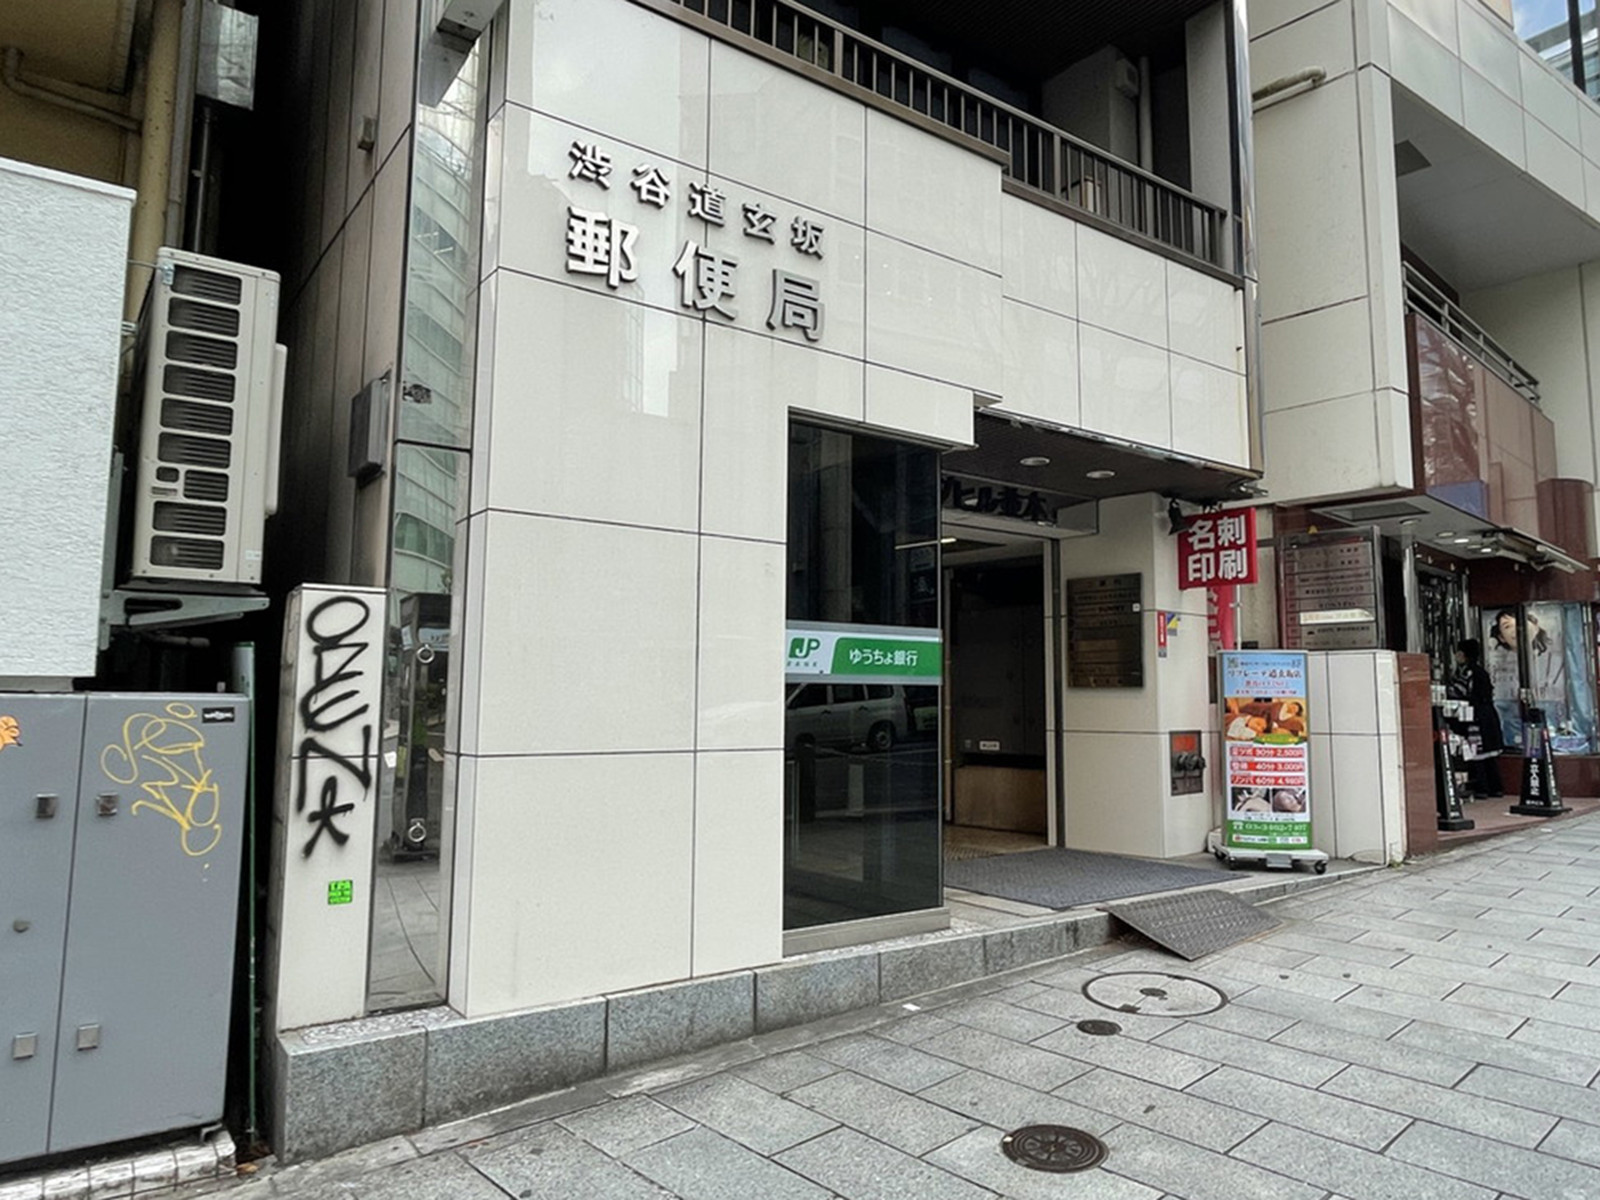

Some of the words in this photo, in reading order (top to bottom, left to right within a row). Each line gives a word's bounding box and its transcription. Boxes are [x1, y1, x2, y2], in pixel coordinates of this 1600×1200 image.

[567, 140, 825, 260] 渋谷道玄坂
[566, 205, 826, 342] 郵便局
[1187, 514, 1247, 551] 名刺
[1187, 547, 1249, 582] 印刷
[788, 637, 821, 660] JP
[849, 648, 919, 668] ゆうちょ銀行
